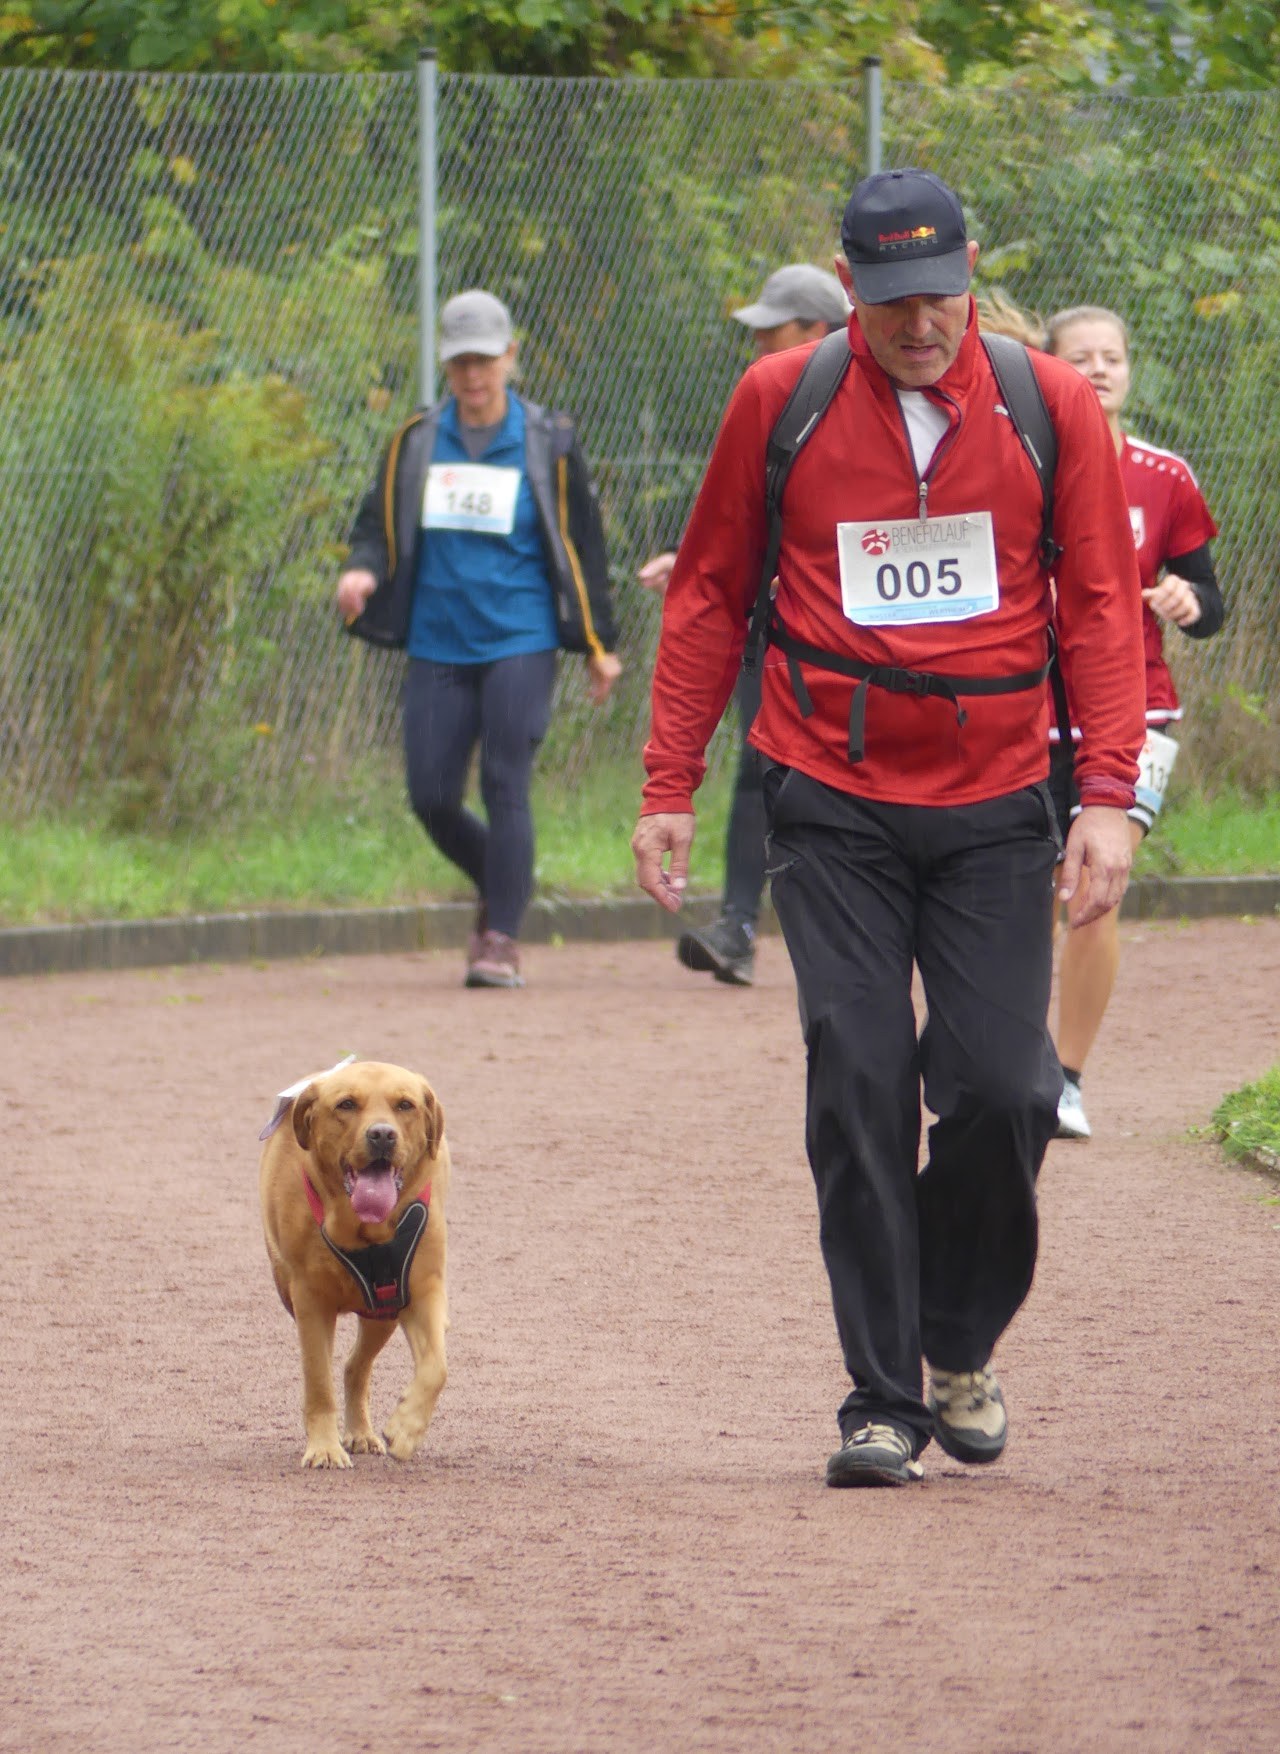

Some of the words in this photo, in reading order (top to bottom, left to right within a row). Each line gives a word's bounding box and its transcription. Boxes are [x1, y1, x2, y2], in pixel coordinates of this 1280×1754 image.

[446, 492, 493, 515] 148
[892, 521, 969, 547] BENEFIZLAUF
[876, 558, 962, 601] 005
